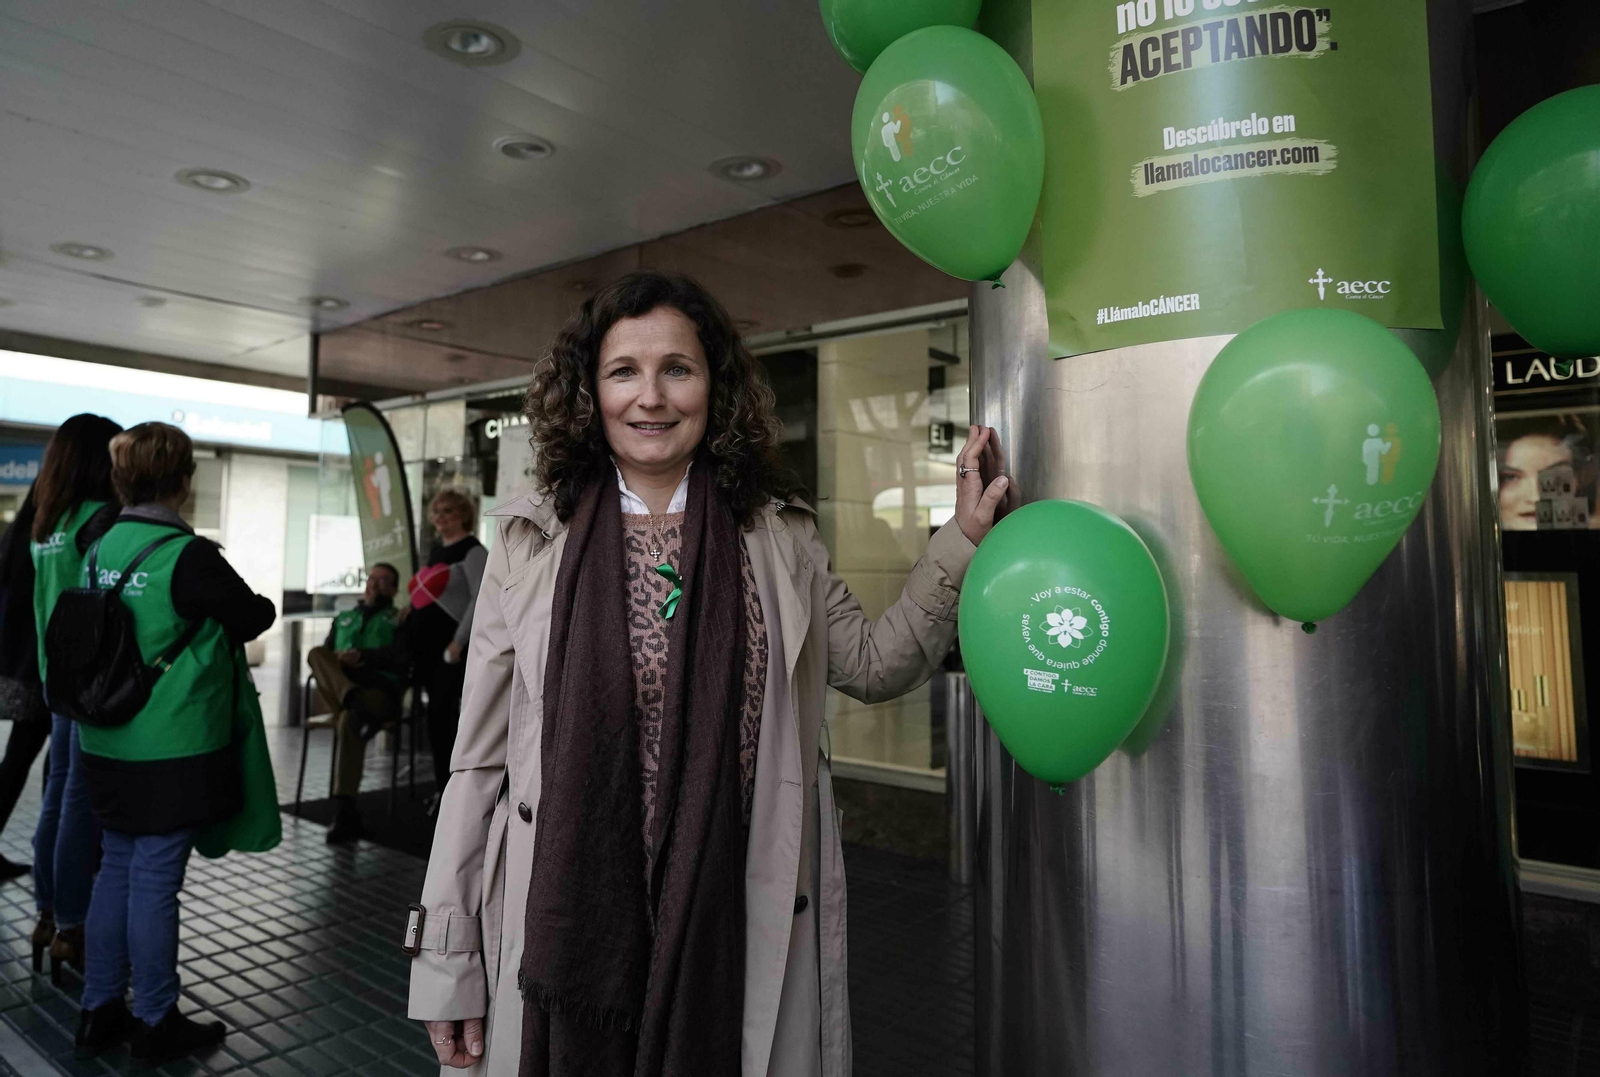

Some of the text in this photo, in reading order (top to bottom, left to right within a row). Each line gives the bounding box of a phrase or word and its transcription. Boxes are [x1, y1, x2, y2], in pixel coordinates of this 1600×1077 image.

[1116, 0, 1157, 34] no
[1163, 112, 1296, 150] Descúbrelo en
[898, 145, 967, 193] aecc
[1143, 145, 1320, 186] llamalocancer.com
[917, 187, 957, 212] NUESTRA
[956, 174, 980, 190] VIDA
[1336, 280, 1391, 294] aecc
[1096, 293, 1200, 325] #LlámaloCÁNCER
[1021, 586, 1110, 671] Voy a estar contigo donde quiera que vayas
[1072, 685, 1098, 693] aecc
